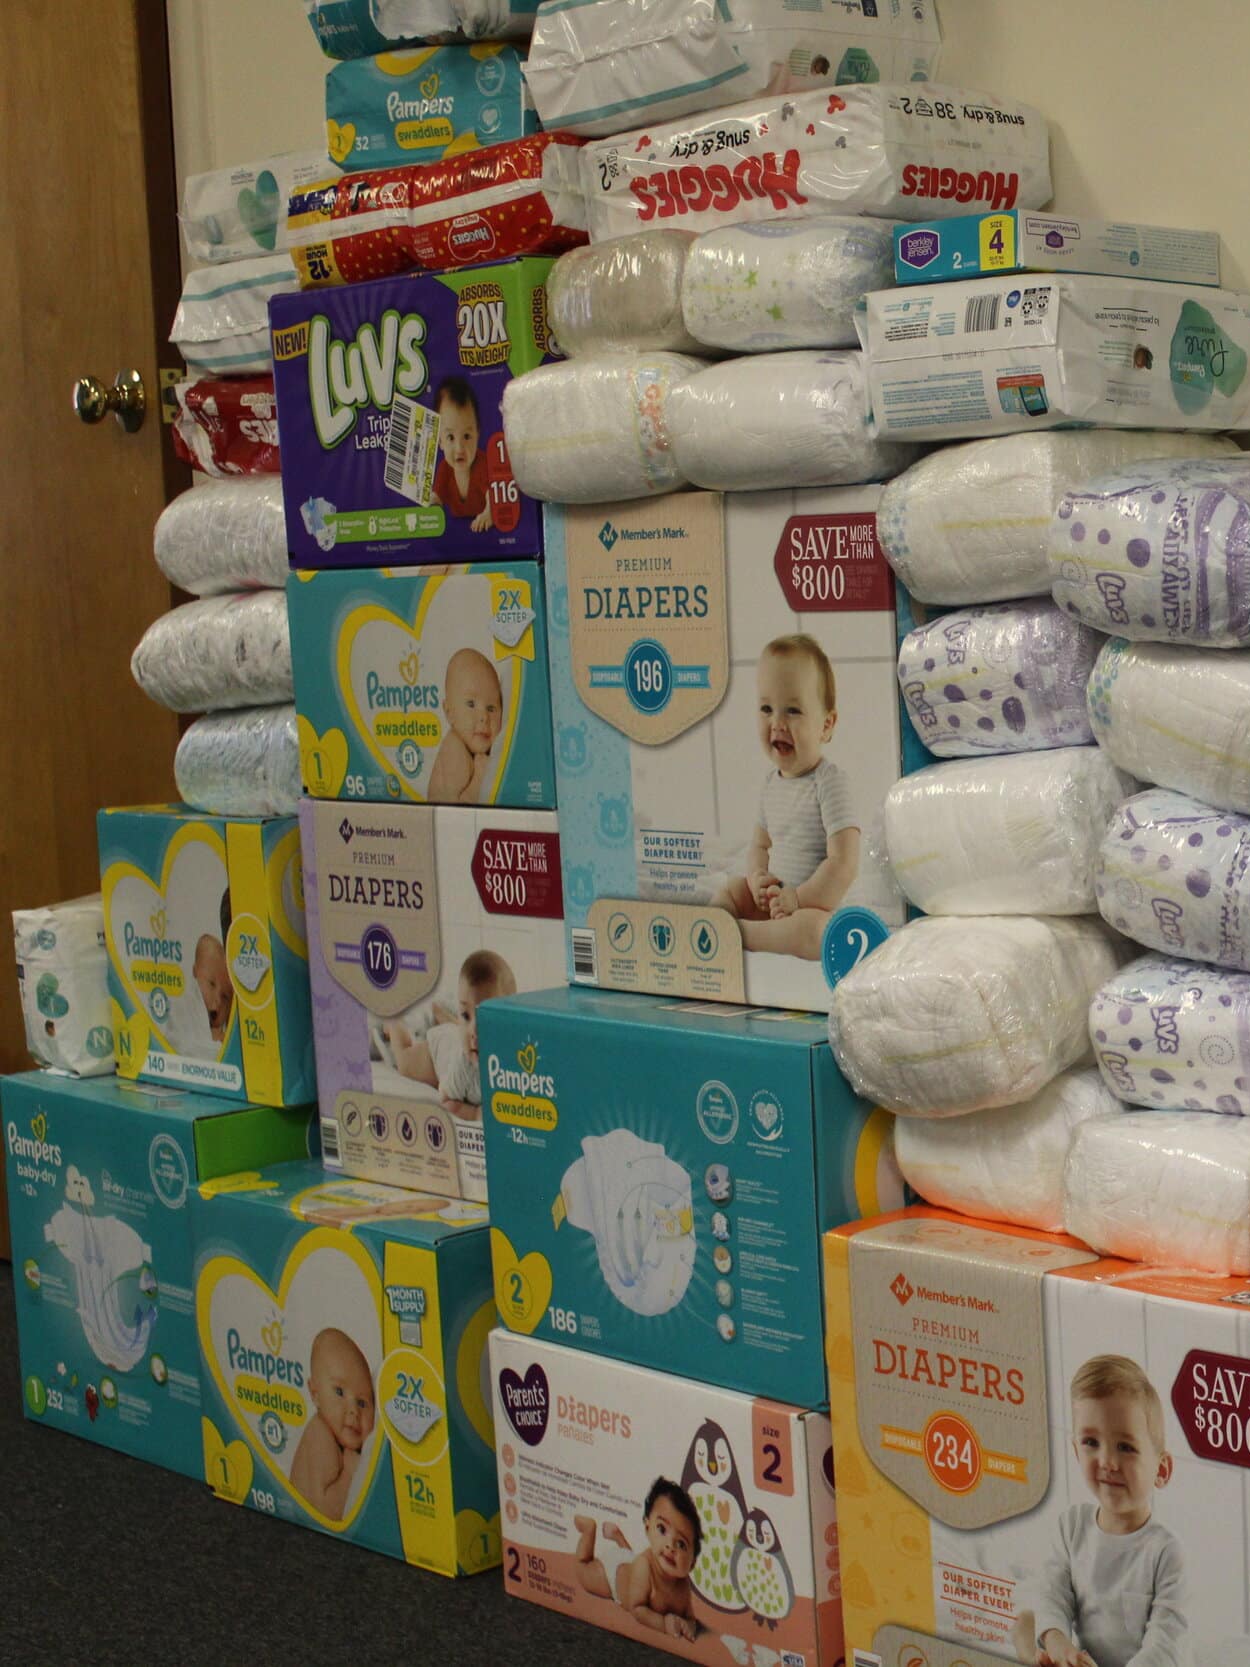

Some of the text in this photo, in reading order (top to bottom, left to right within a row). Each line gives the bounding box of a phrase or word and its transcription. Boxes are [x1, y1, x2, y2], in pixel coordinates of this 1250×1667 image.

[386, 91, 454, 122] Pampers
[355, 136, 369, 150] 32
[397, 123, 451, 143] swaddlers
[629, 149, 809, 221] HUGGIES
[902, 164, 1018, 210] HUGGIES
[989, 229, 1004, 254] 4
[952, 252, 962, 269] 2
[460, 284, 501, 302] ABSORBS
[458, 302, 507, 348] 20X
[533, 287, 545, 351] ABSORBS
[275, 334, 307, 357] NEW!
[460, 348, 510, 364] ITS WEIGHT
[497, 441, 505, 463] 1
[491, 481, 518, 503] 116
[620, 529, 662, 542] Member's
[791, 526, 849, 561] SAVE
[850, 524, 874, 543] MORE
[851, 541, 874, 560] THAN
[616, 558, 672, 572] PREMIUM
[792, 563, 845, 601] $800
[498, 590, 521, 610] 2X
[584, 585, 709, 619] DIAPERS
[496, 611, 527, 624] SOFTER
[634, 659, 663, 693] 196
[366, 671, 439, 713] Pampers
[376, 721, 438, 737] swaddlers
[313, 752, 323, 780] 1
[346, 776, 366, 796] 96
[355, 826, 386, 839] Member's
[643, 837, 701, 849] OUR SOFTEST
[353, 851, 395, 866] PREMIUM
[482, 839, 528, 872] SAVE
[528, 842, 546, 859] MORE
[644, 848, 675, 860] DIAPER
[529, 857, 548, 873] THAN
[328, 874, 424, 910] DIAPERS
[485, 873, 526, 907] $800
[124, 921, 182, 963] Pampers
[239, 935, 258, 956] 2X
[367, 940, 392, 972] 176
[132, 970, 182, 987] swaddlers
[245, 1020, 264, 1041] 12h
[119, 1031, 131, 1056] N
[488, 1054, 556, 1100] Pampers
[496, 1100, 555, 1123] swaddlers
[7, 1121, 62, 1167] Pampers
[17, 1162, 57, 1187] baby-dry
[391, 1287, 424, 1302] MONTH
[509, 1273, 524, 1304] 2
[917, 1286, 966, 1308] Member's
[394, 1300, 425, 1313] SUPPLY
[548, 1306, 577, 1335] 186
[912, 1317, 980, 1345] PREMIUM
[226, 1328, 304, 1388] Pampers
[872, 1339, 1025, 1406] DIAPERS
[396, 1373, 424, 1402] 2X
[506, 1380, 546, 1408] Parent's
[237, 1384, 303, 1417] swaddlers
[393, 1397, 432, 1418] SOFTER
[515, 1409, 543, 1426] CHOICE
[557, 1395, 632, 1439] Diapers
[762, 1425, 780, 1439] size
[762, 1444, 782, 1484] 2
[932, 1432, 972, 1475] 234
[219, 1457, 229, 1485] 1
[251, 1488, 275, 1513] 198
[405, 1474, 435, 1503] 12h
[507, 1547, 522, 1583] 2
[527, 1554, 546, 1573] 160
[943, 1570, 1013, 1598] OUR SOFTEST
[943, 1584, 982, 1603] DIAPER
